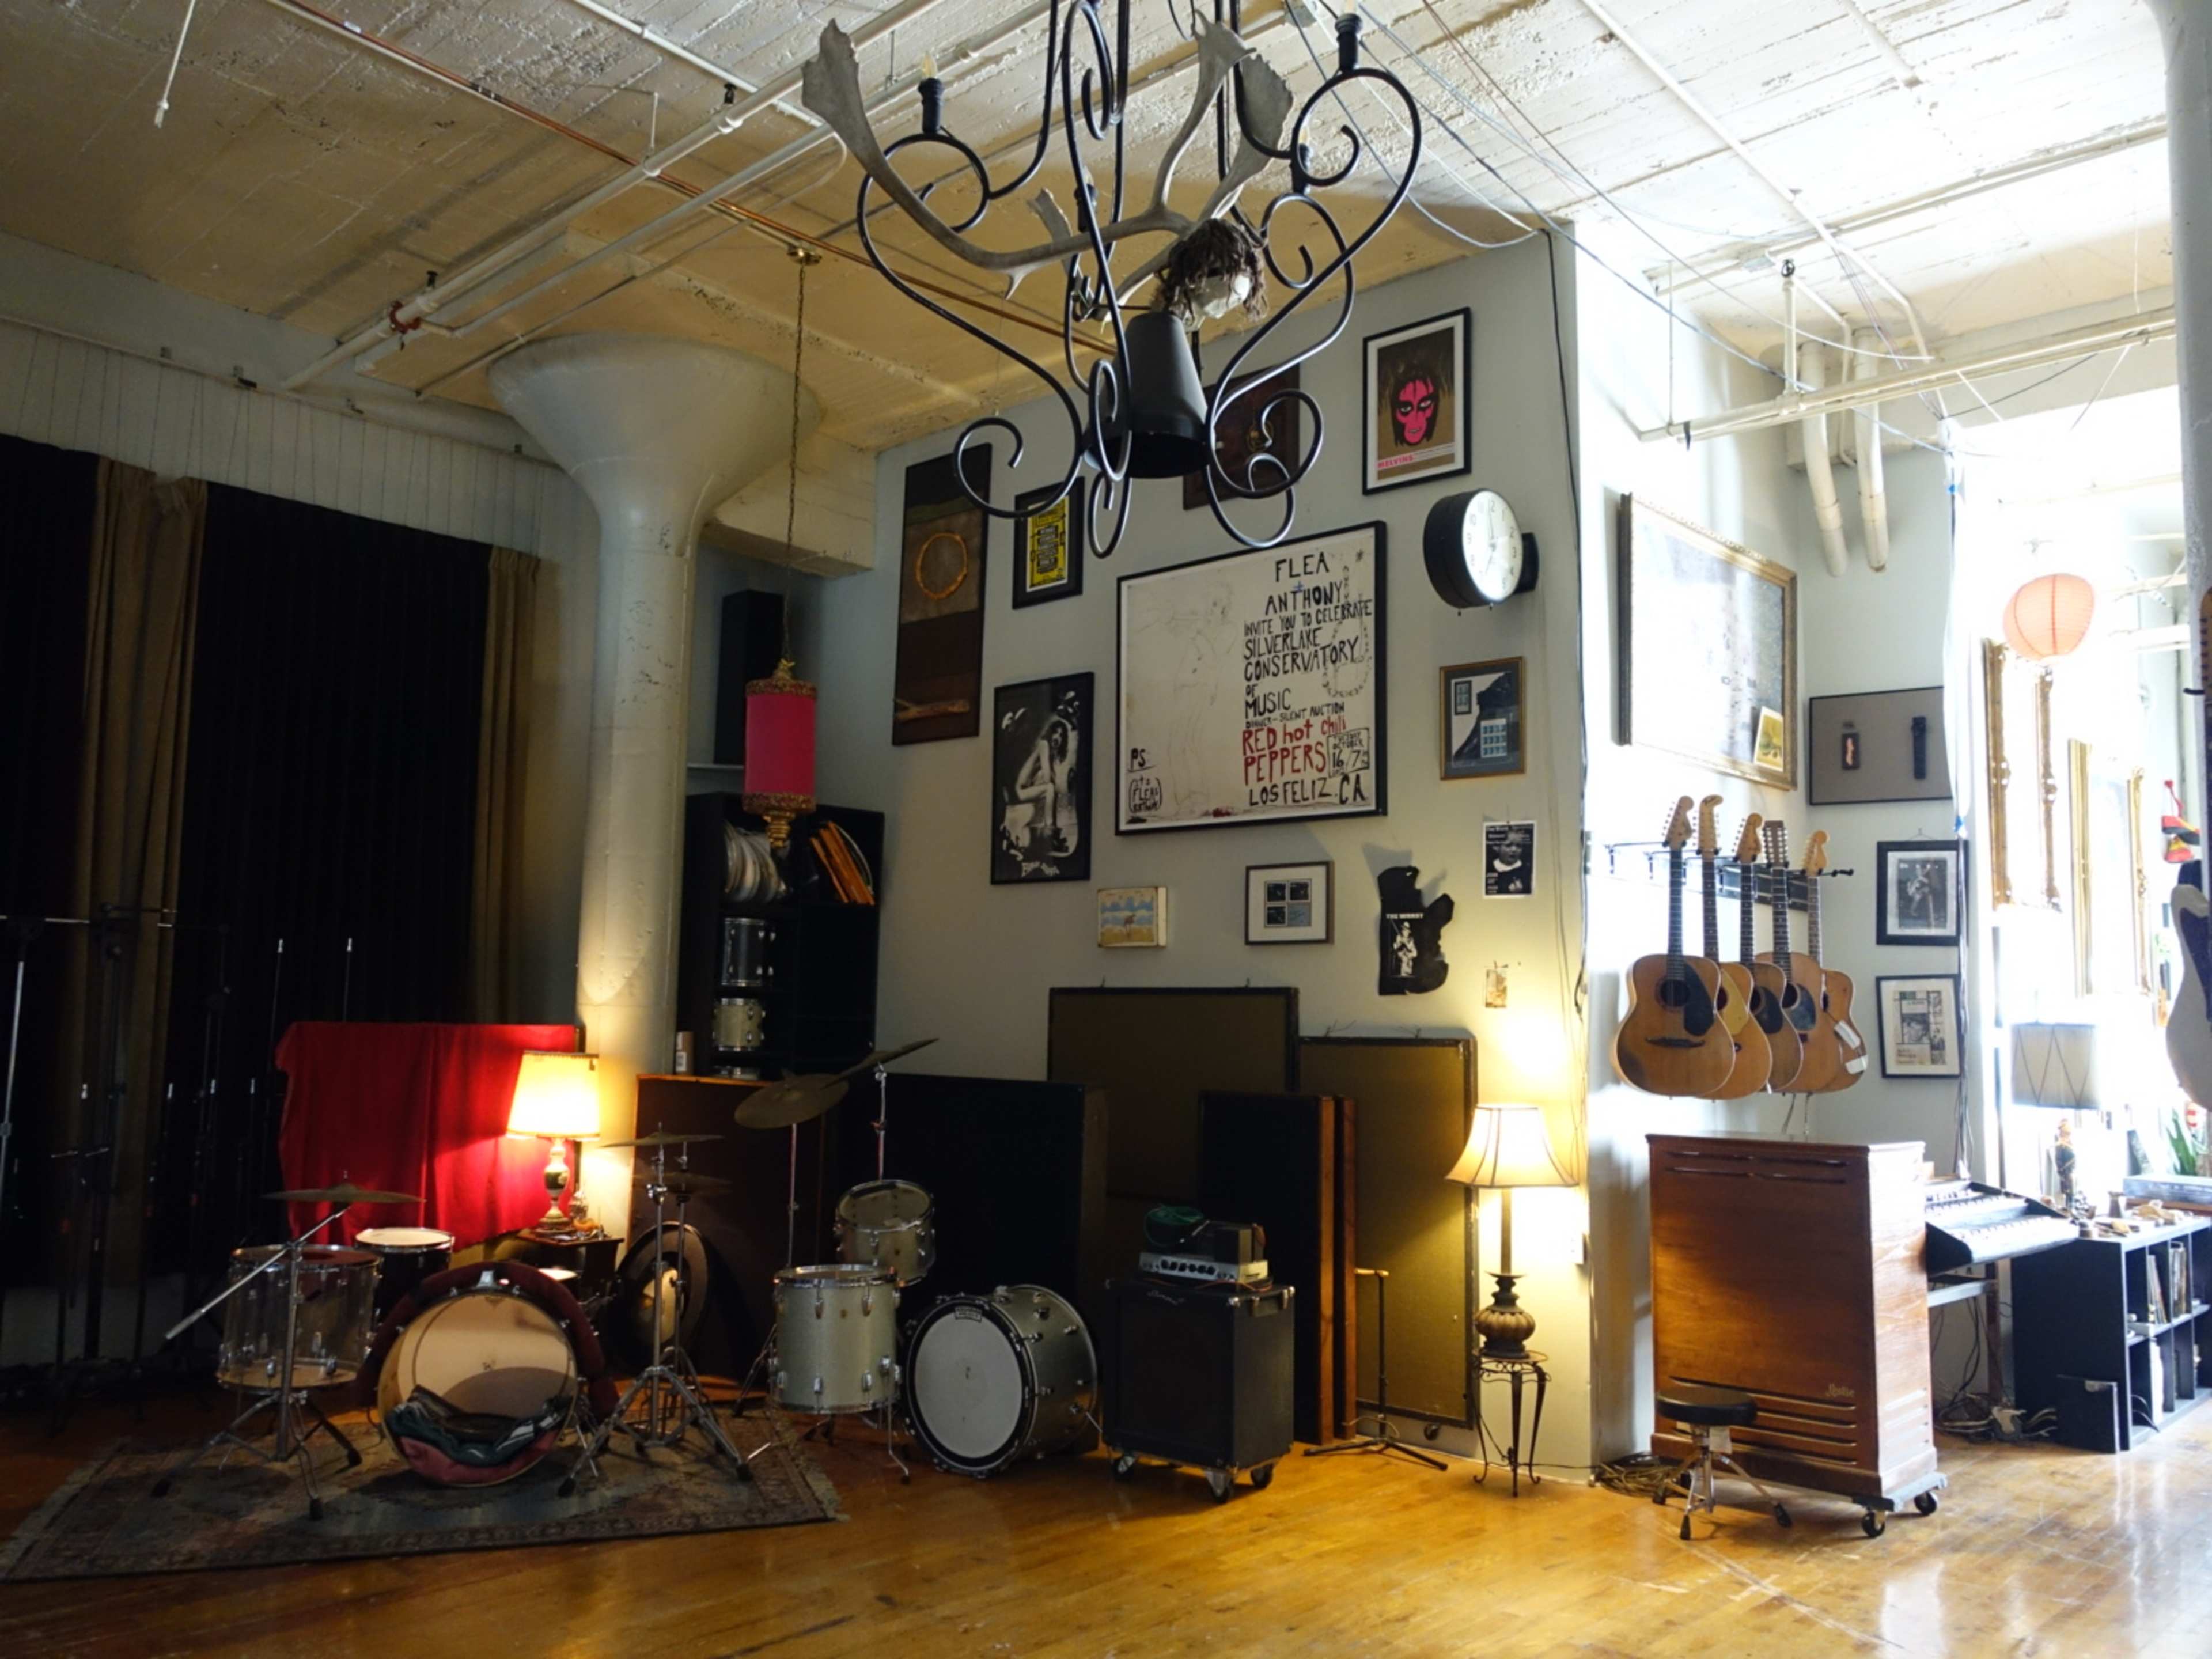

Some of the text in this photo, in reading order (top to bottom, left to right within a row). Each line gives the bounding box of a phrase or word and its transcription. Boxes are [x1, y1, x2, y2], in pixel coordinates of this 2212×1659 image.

[1377, 454, 1414, 469] MELVINS
[1275, 551, 1329, 582] FLEA
[1265, 581, 1343, 616] ANTHONY
[1244, 599, 1373, 636] INVITE YOU TO CELEBRATE
[1244, 627, 1322, 660] SILVERLAKE
[1244, 635, 1359, 682] CONSERVATORY
[1245, 684, 1258, 698] OF
[1245, 688, 1291, 719] MUSIC
[1310, 702, 1344, 717] AUCTION
[1243, 726, 1277, 756] RED
[1283, 719, 1313, 744] hot
[1244, 741, 1327, 786] PEPPERS
